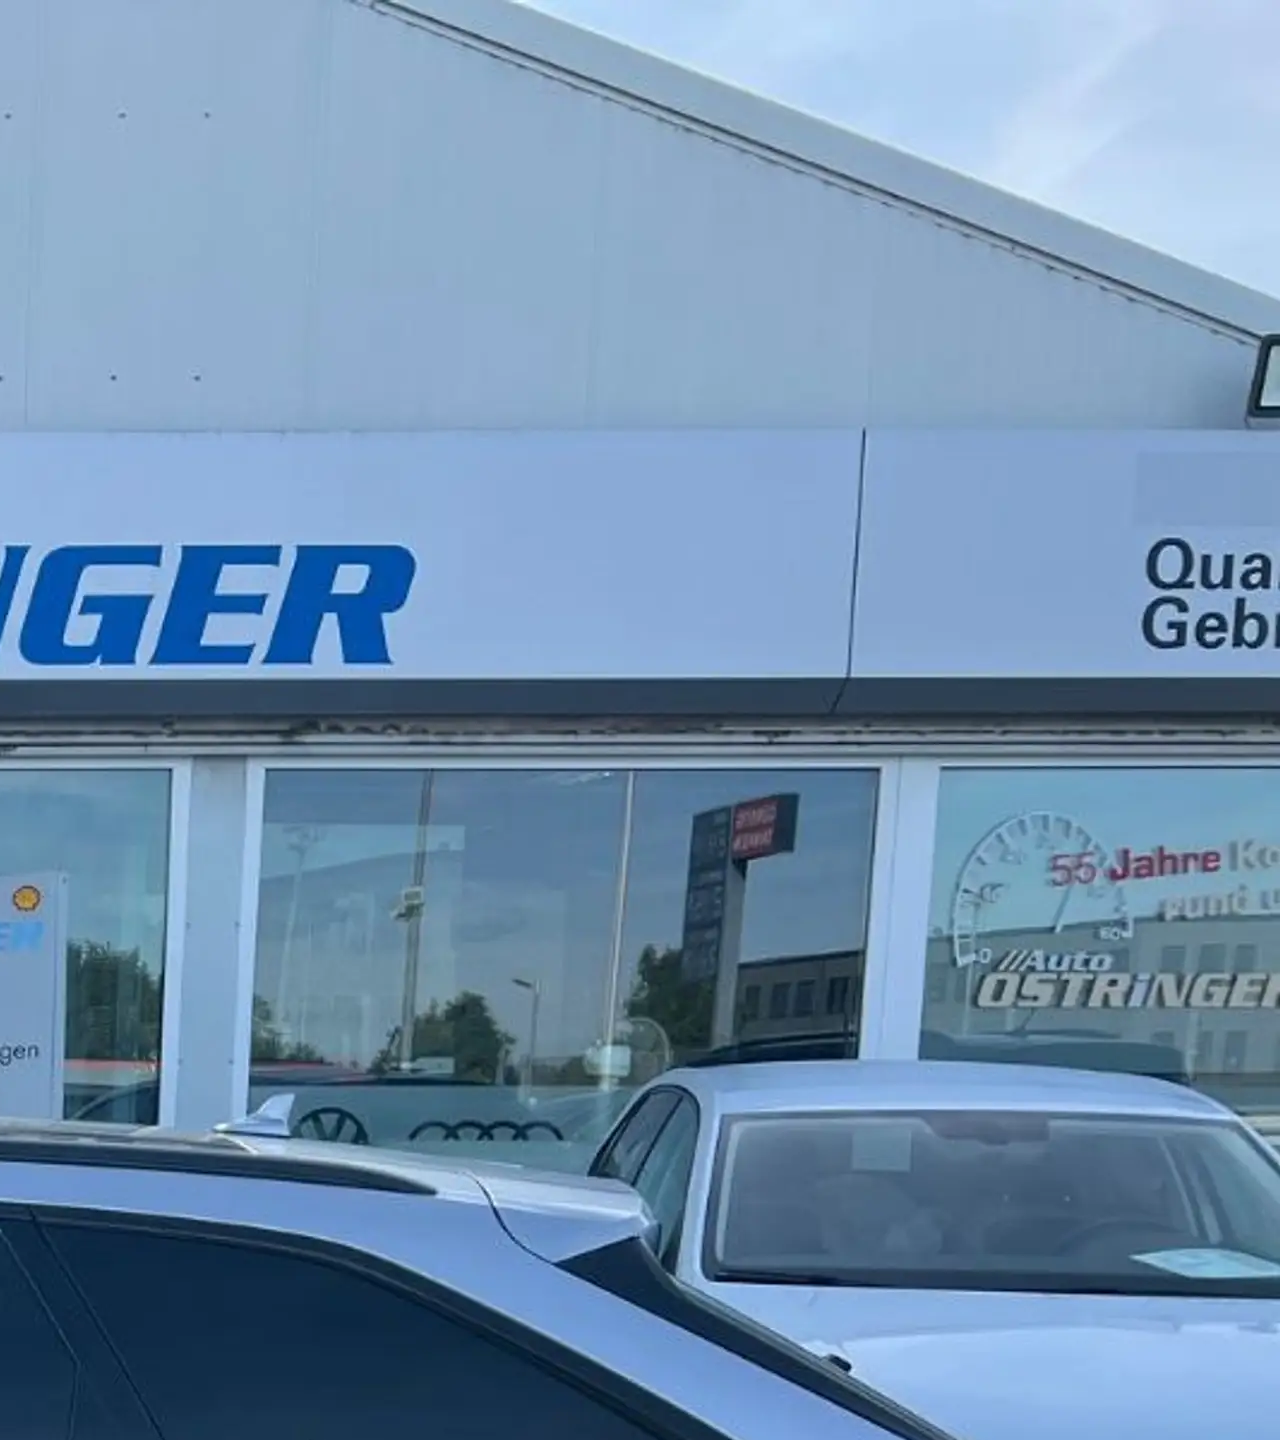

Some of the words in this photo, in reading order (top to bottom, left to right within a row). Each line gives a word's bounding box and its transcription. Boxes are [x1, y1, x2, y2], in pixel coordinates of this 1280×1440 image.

[1146, 537, 1280, 592] Qua
[1050, 852, 1098, 888] 55
[1108, 844, 1222, 883] Jahre
